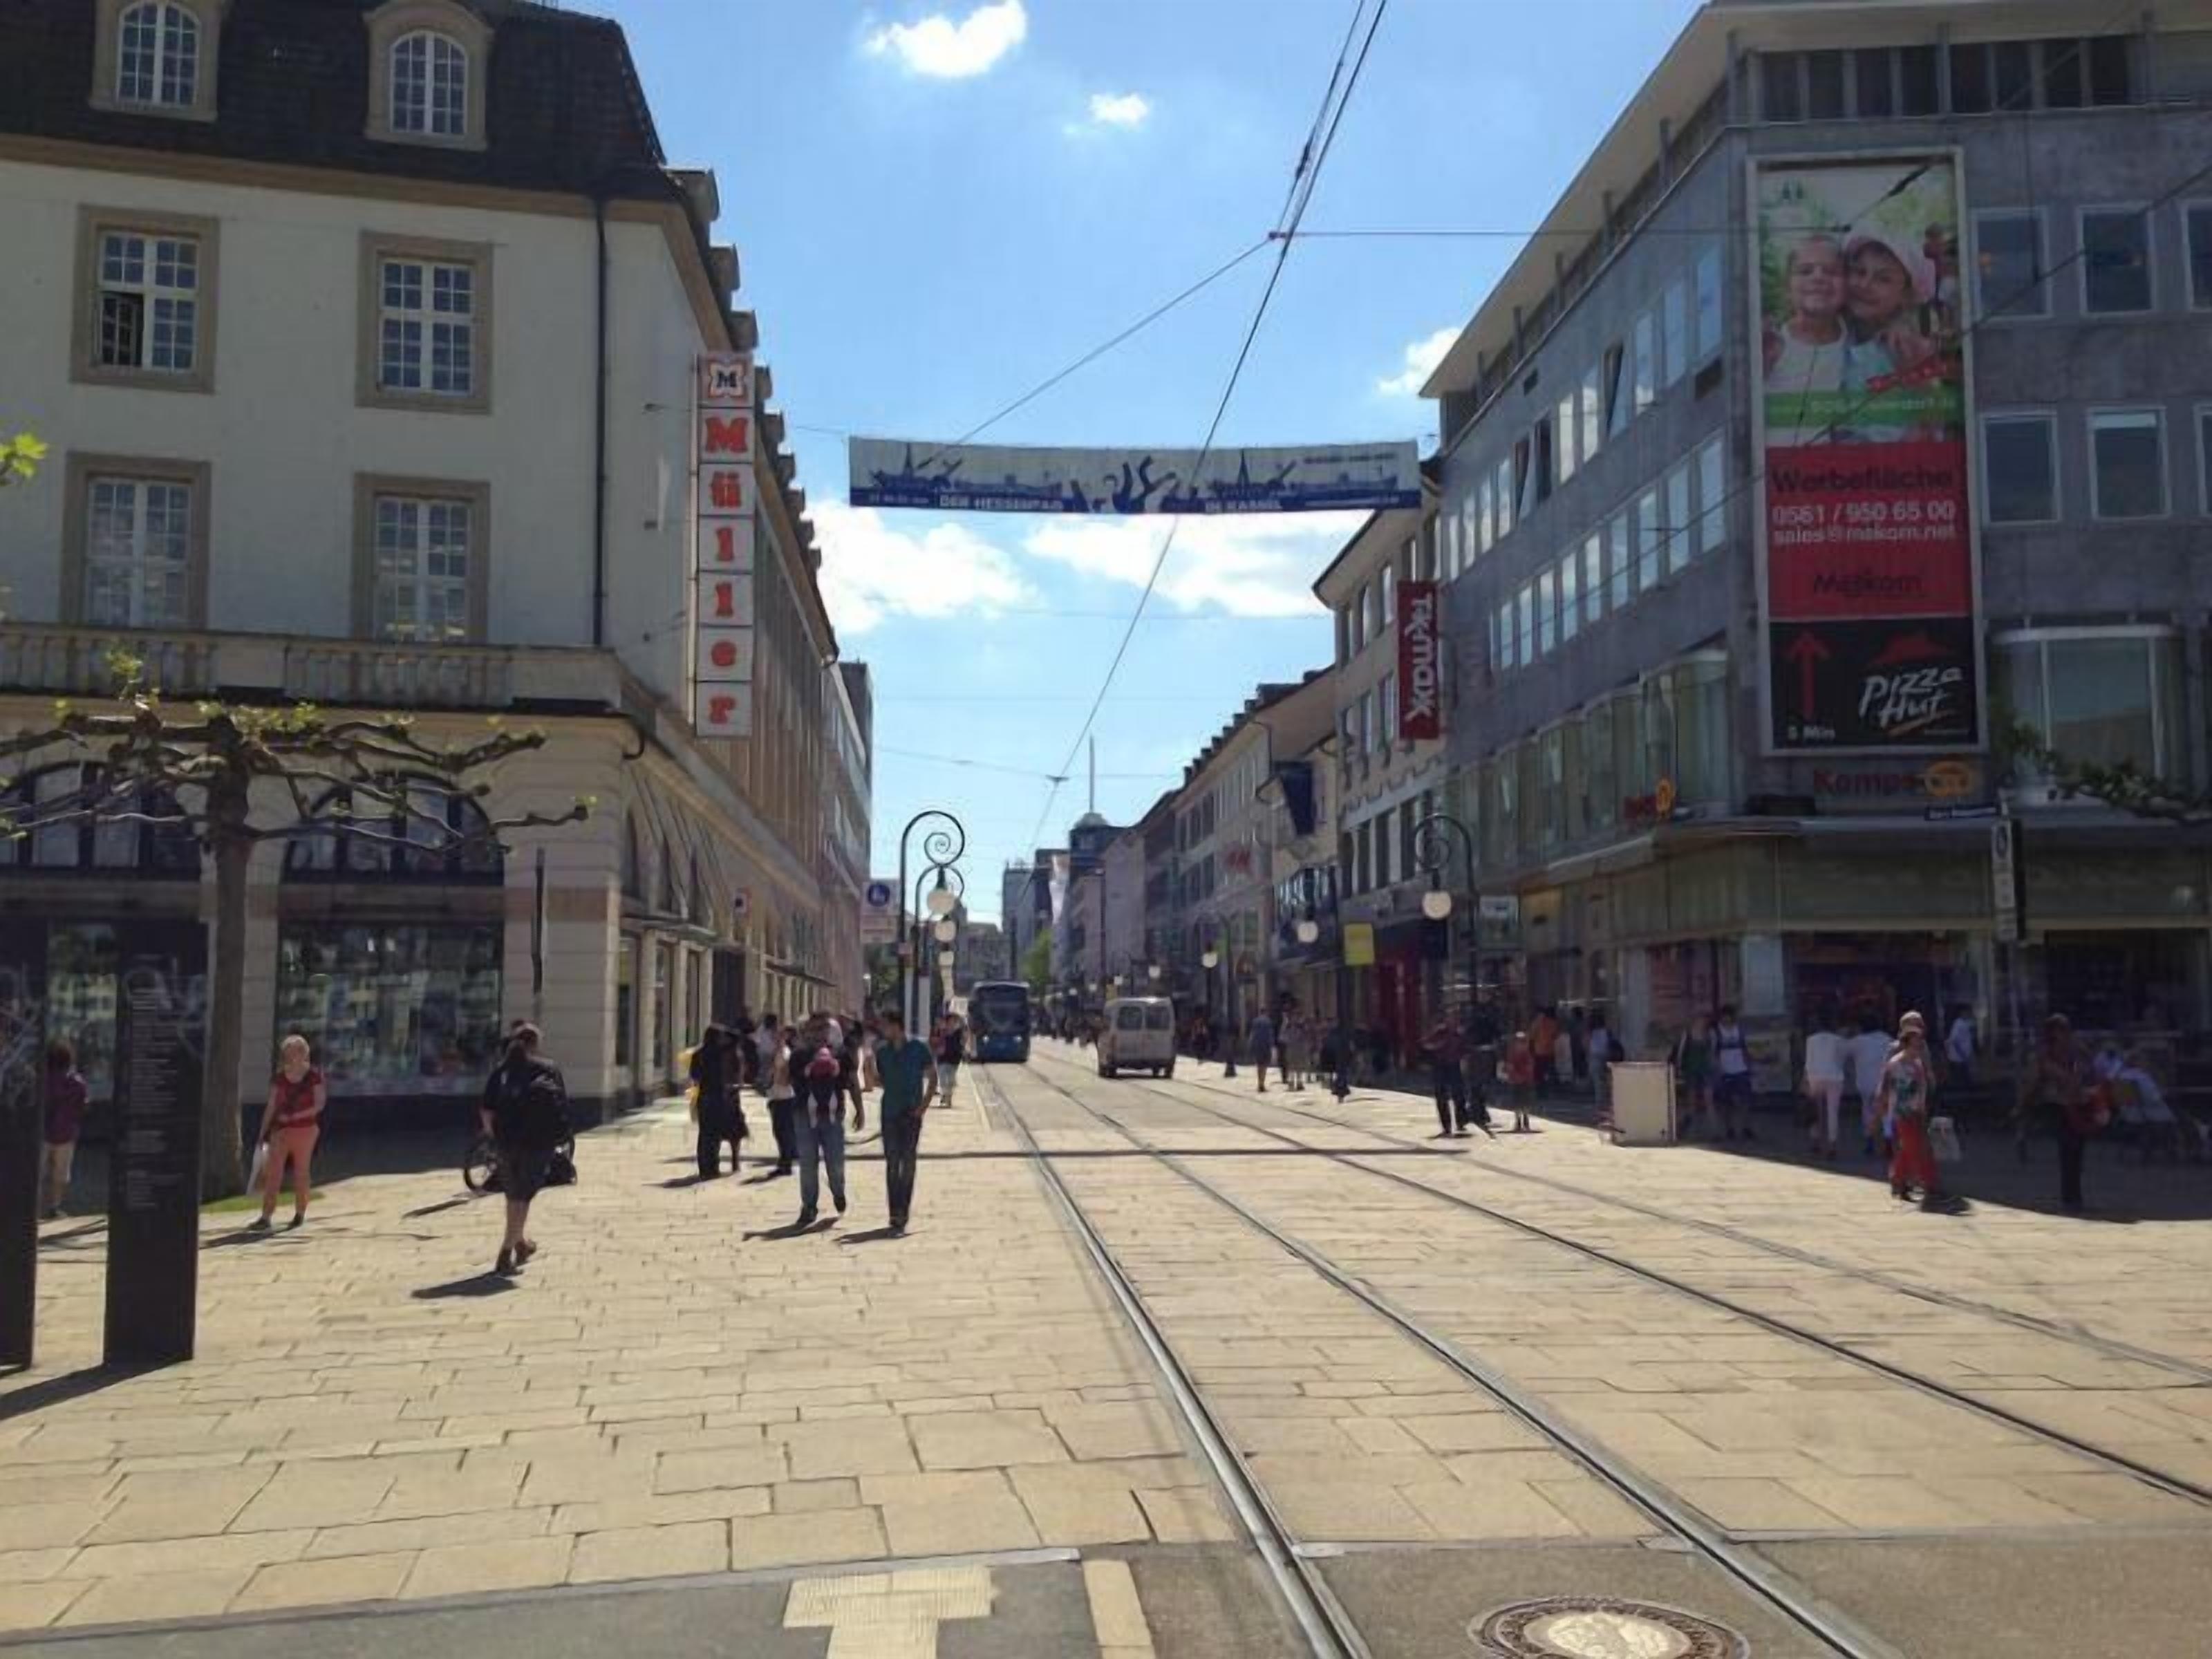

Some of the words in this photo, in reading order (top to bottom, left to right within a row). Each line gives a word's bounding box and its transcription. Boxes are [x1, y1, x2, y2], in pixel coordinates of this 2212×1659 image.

[1846, 500, 1887, 523] 950
[1893, 499, 1921, 520] 65
[1927, 498, 1957, 519] 00
[1859, 667, 1964, 718] Pizza
[1879, 689, 1949, 729] Hut
